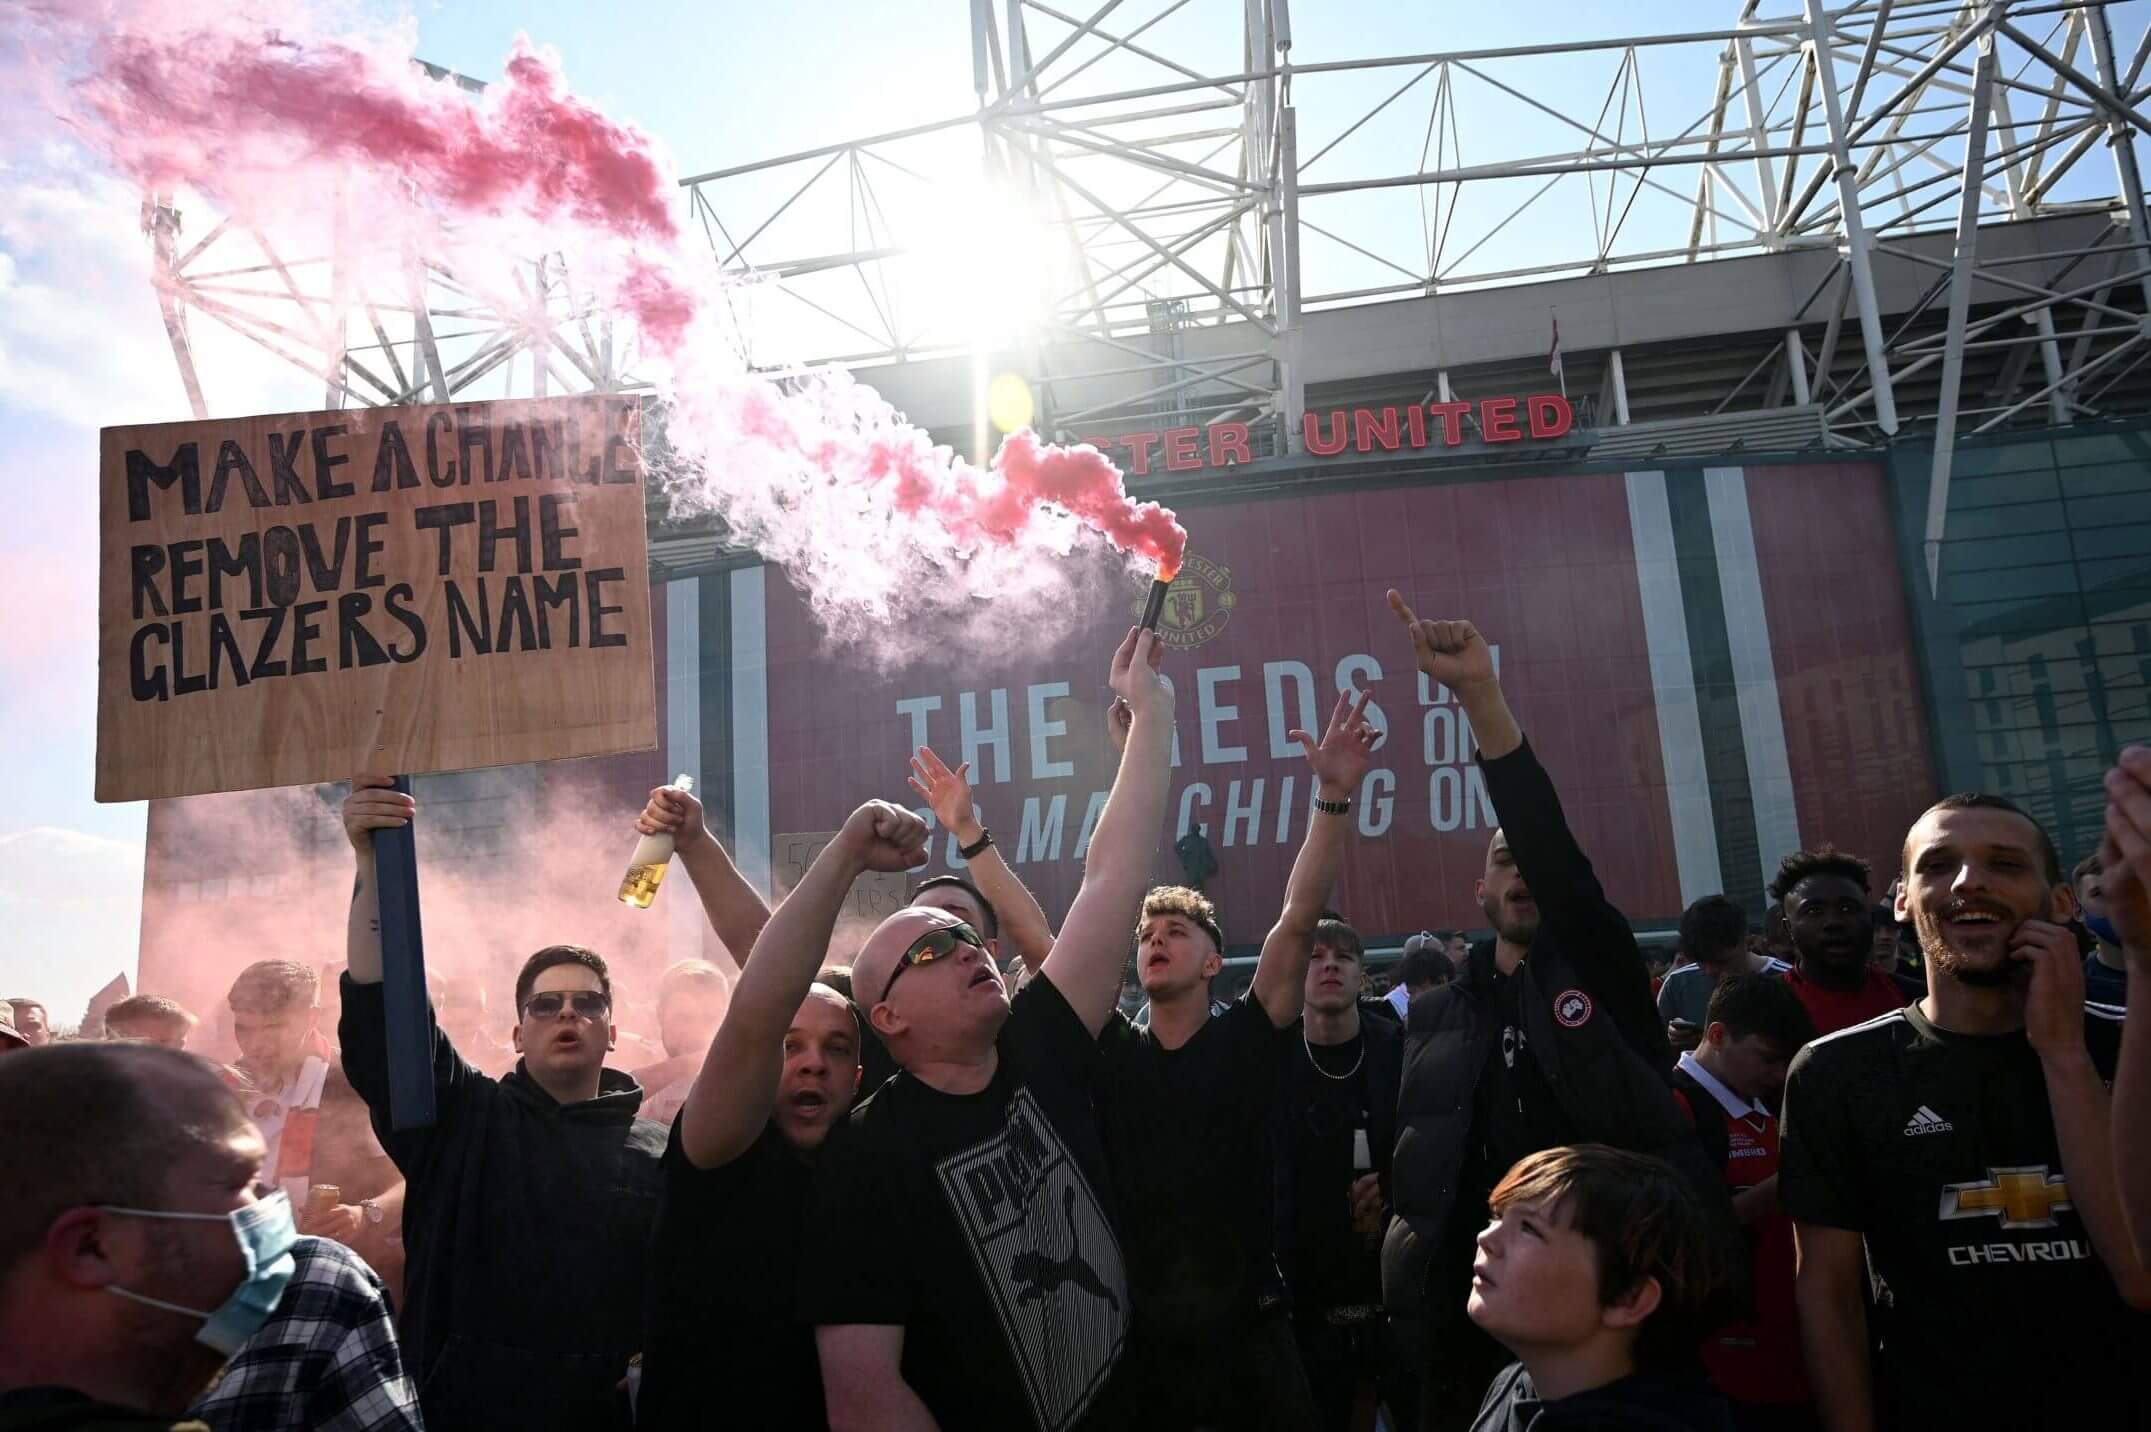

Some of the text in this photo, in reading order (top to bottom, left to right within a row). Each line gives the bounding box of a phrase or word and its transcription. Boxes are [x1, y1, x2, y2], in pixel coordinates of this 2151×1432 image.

[125, 424, 356, 522] MAKE
[372, 420, 421, 492] A
[1303, 395, 1574, 455] UNITED
[130, 492, 582, 620] REMOVE THE
[130, 567, 628, 702] GLAZERS NAME
[896, 681, 1075, 789] THE
[1160, 654, 1388, 767] EDS
[1903, 1119, 1953, 1137] adidas
[1947, 1239, 2091, 1266] CHEVROL
